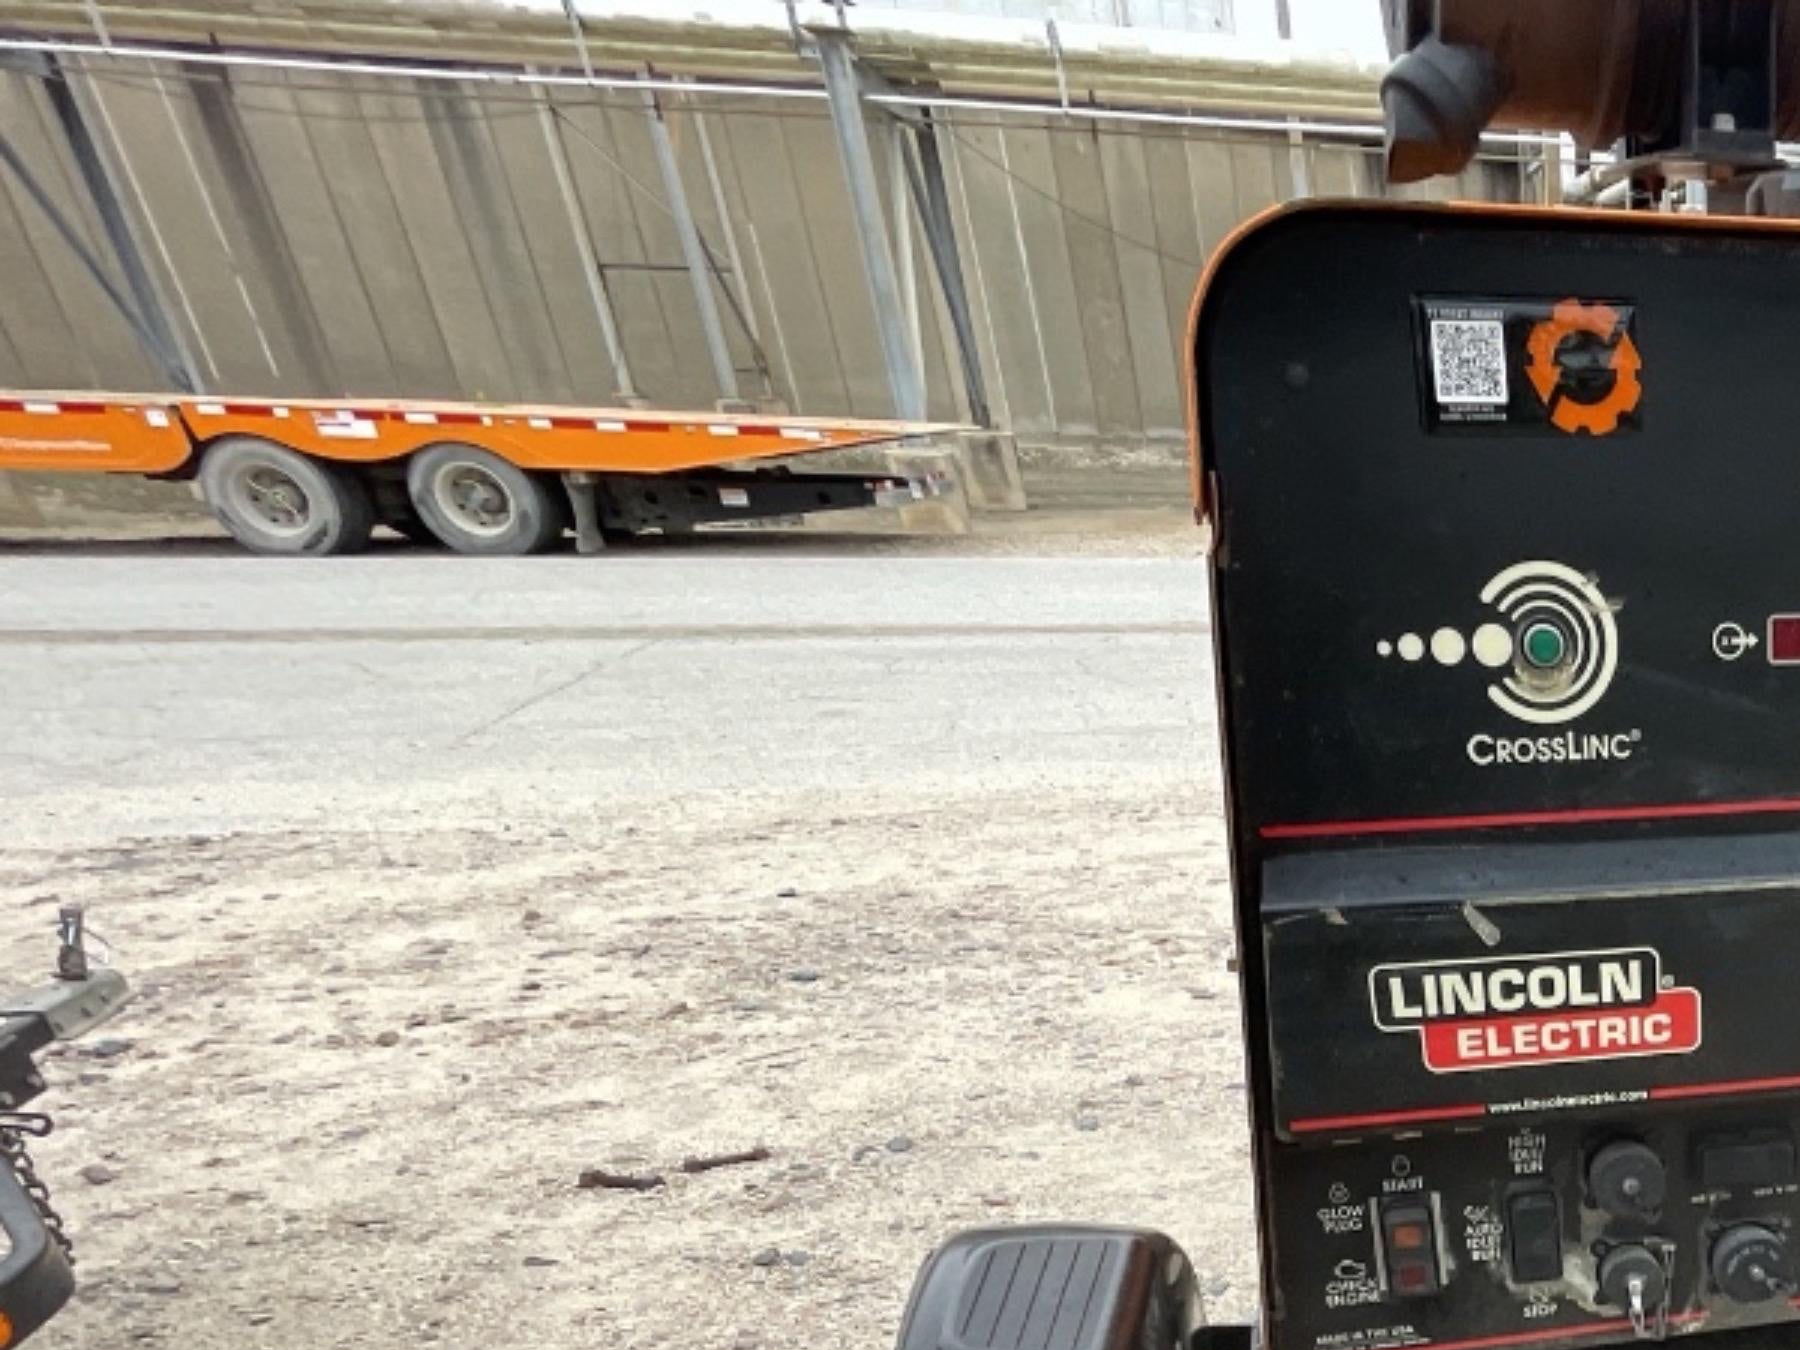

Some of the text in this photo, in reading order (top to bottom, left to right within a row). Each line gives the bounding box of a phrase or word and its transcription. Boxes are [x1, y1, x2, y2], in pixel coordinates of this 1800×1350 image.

[1387, 960, 1644, 1019] LINCOLN
[1456, 1013, 1673, 1060] ELECTRIC
[1382, 1176, 1424, 1193] START
[1317, 1205, 1366, 1221] GLOW
[1522, 1302, 1558, 1319] STOP
